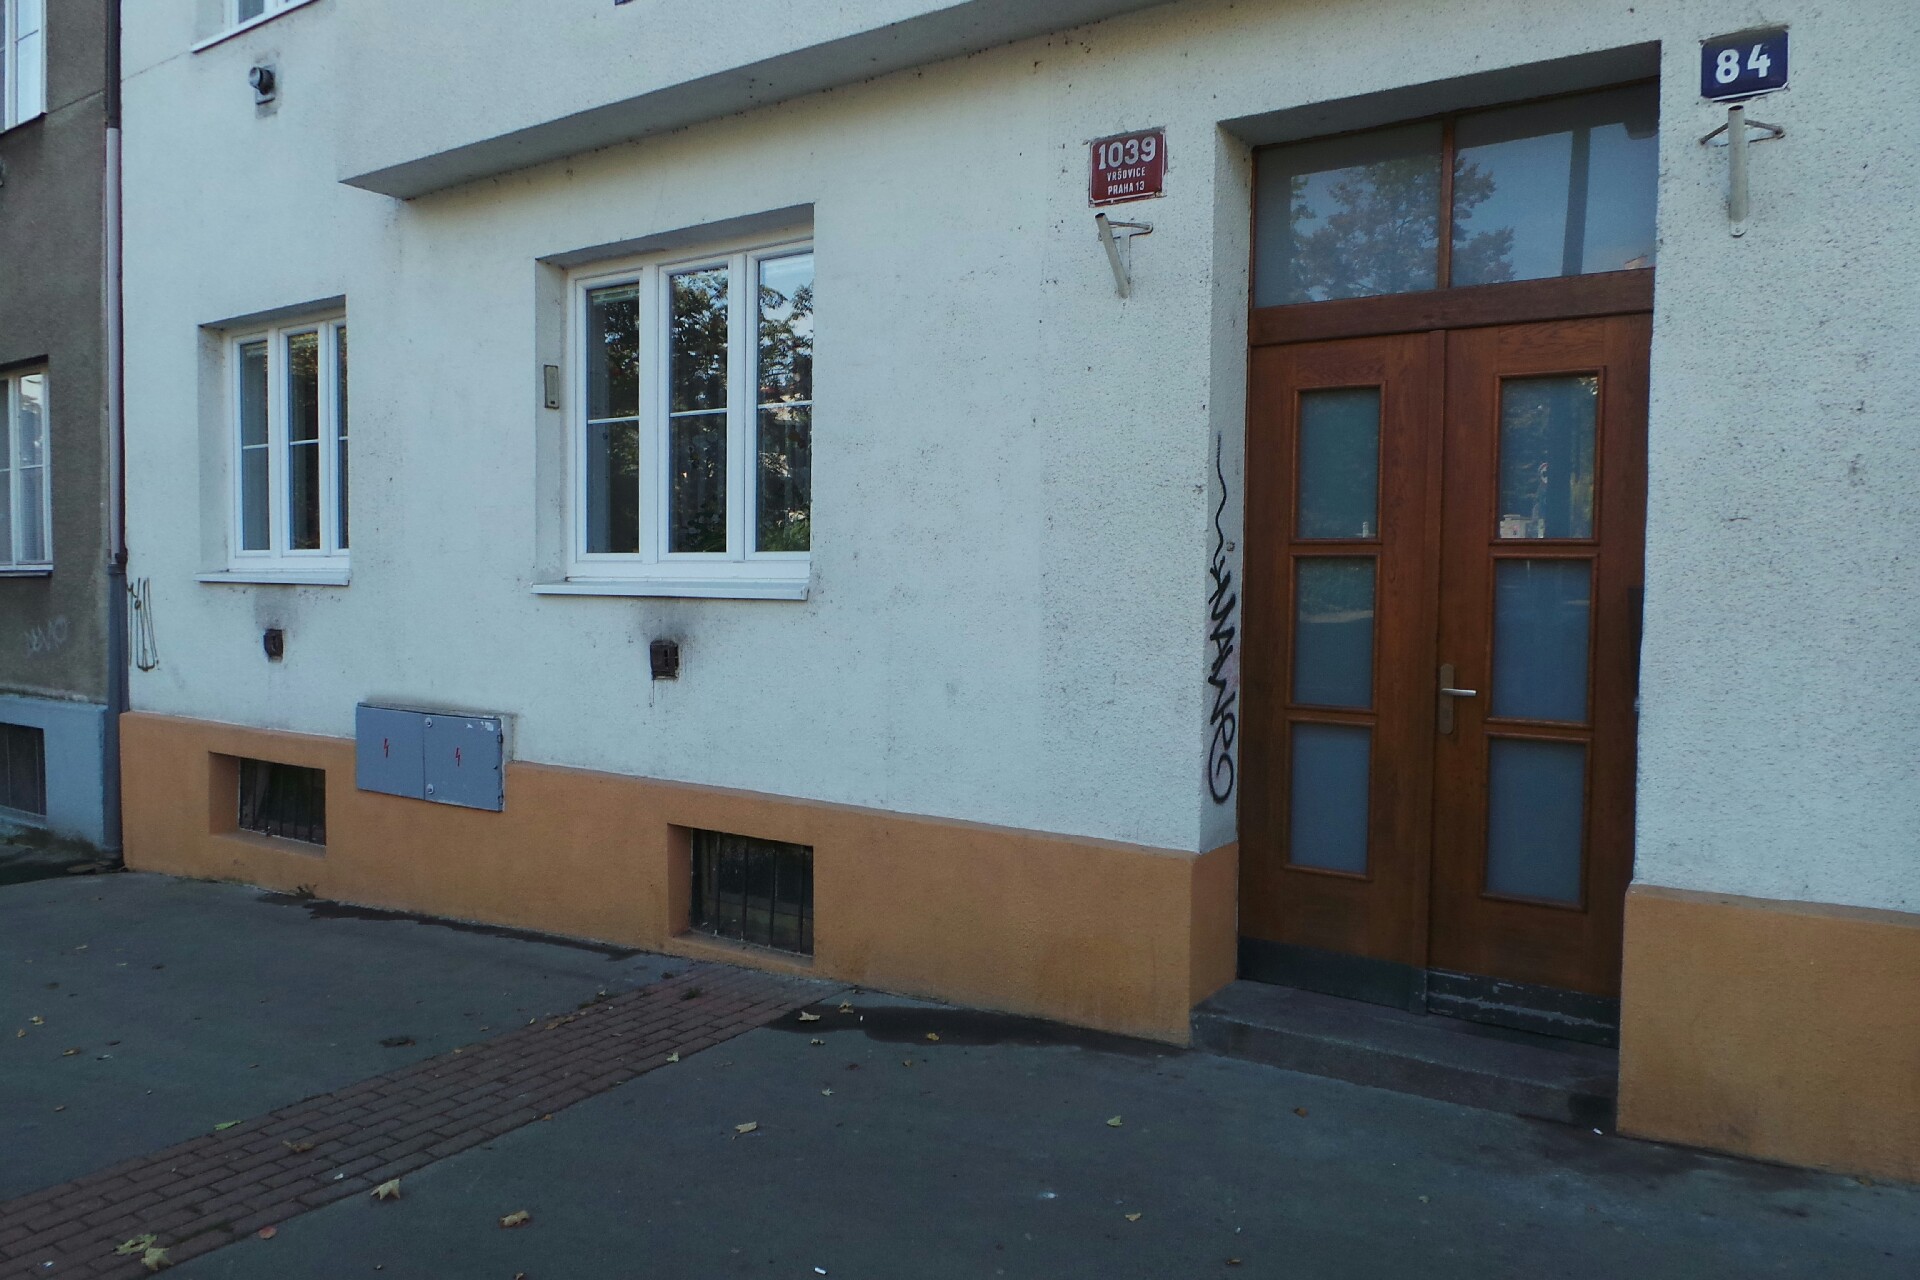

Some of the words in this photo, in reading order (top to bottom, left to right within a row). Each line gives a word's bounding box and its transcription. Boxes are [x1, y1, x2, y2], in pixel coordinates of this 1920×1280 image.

[1715, 43, 1771, 84] 84
[1098, 136, 1156, 170] 1039
[1106, 166, 1146, 182] VRŠOVICE
[1107, 182, 1134, 196] PRAHA
[1135, 180, 1145, 191] 13
